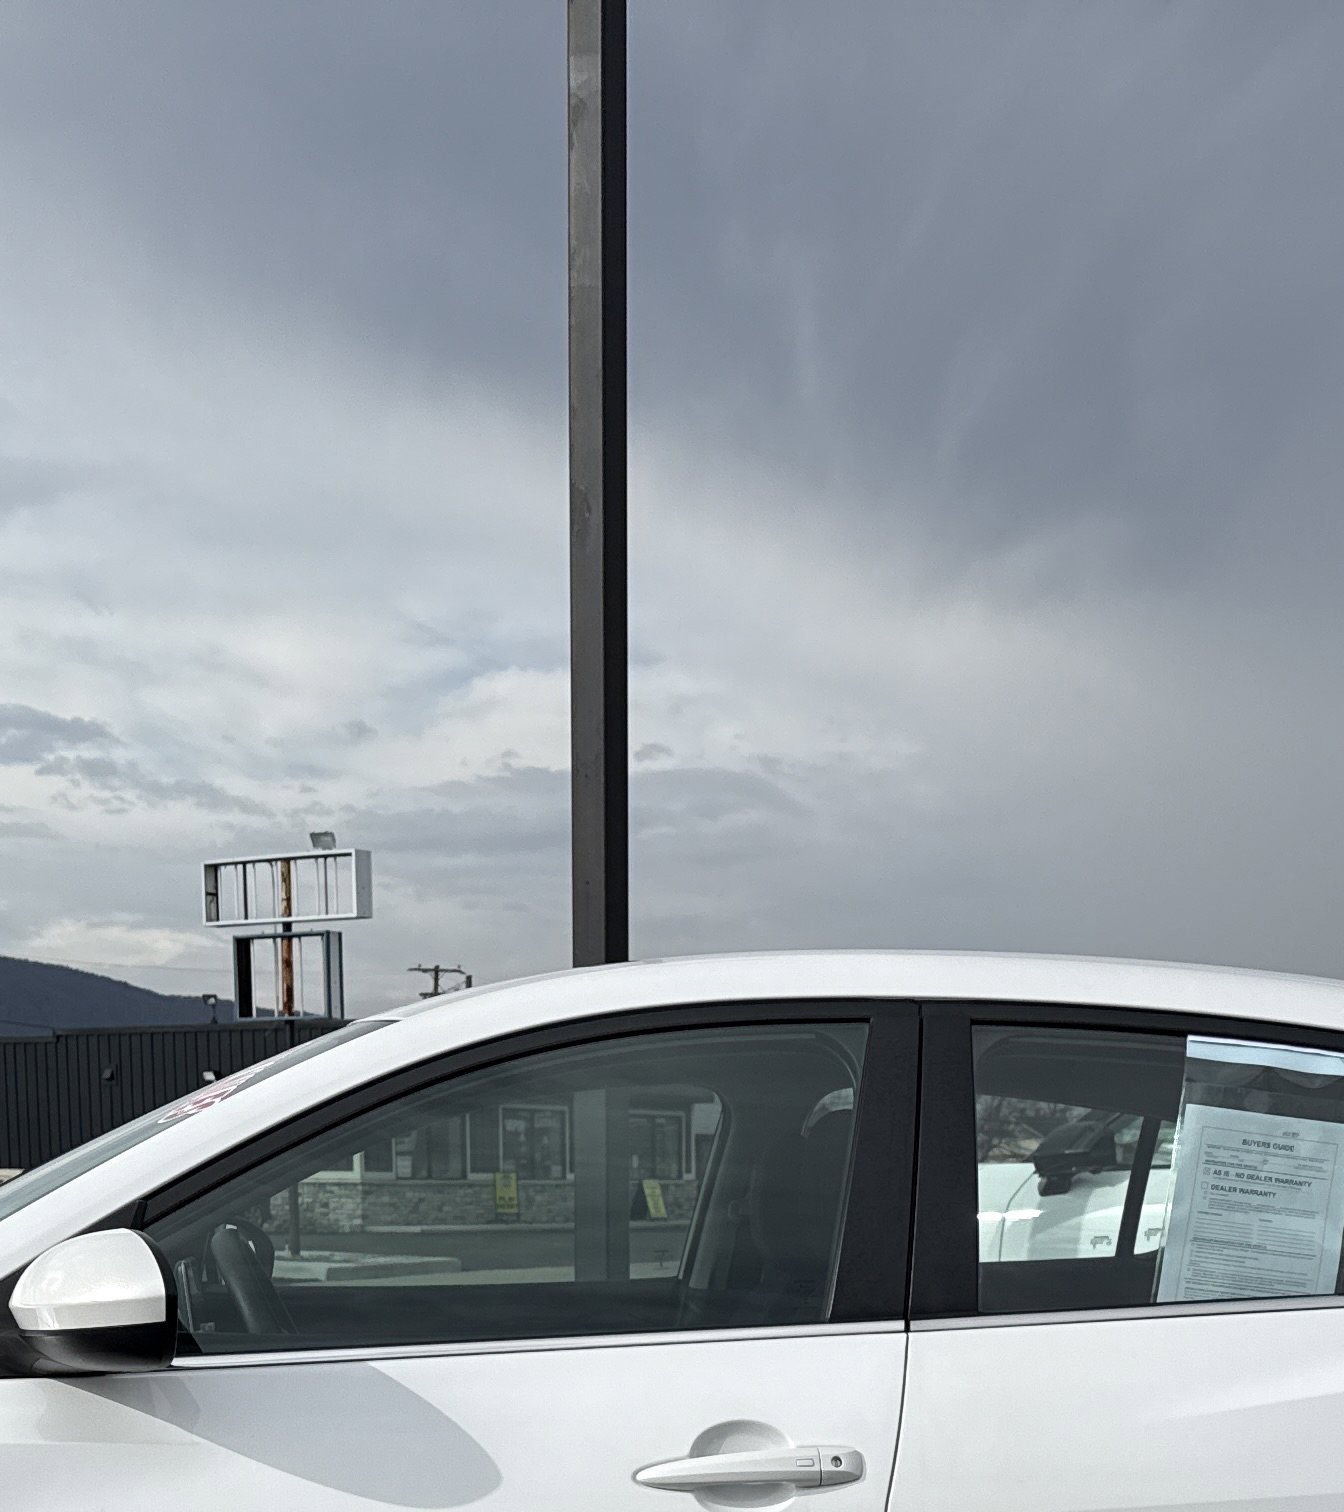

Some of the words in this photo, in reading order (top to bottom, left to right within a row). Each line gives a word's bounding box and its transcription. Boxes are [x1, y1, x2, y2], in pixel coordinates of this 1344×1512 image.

[1241, 1138, 1272, 1149] BUYERS
[1272, 1142, 1295, 1153] GUIDE
[1246, 1173, 1273, 1183] DEALER
[1274, 1177, 1313, 1188] WARRANTY
[1210, 1183, 1237, 1193] DEALER
[1238, 1187, 1277, 1199] WARRANTY
